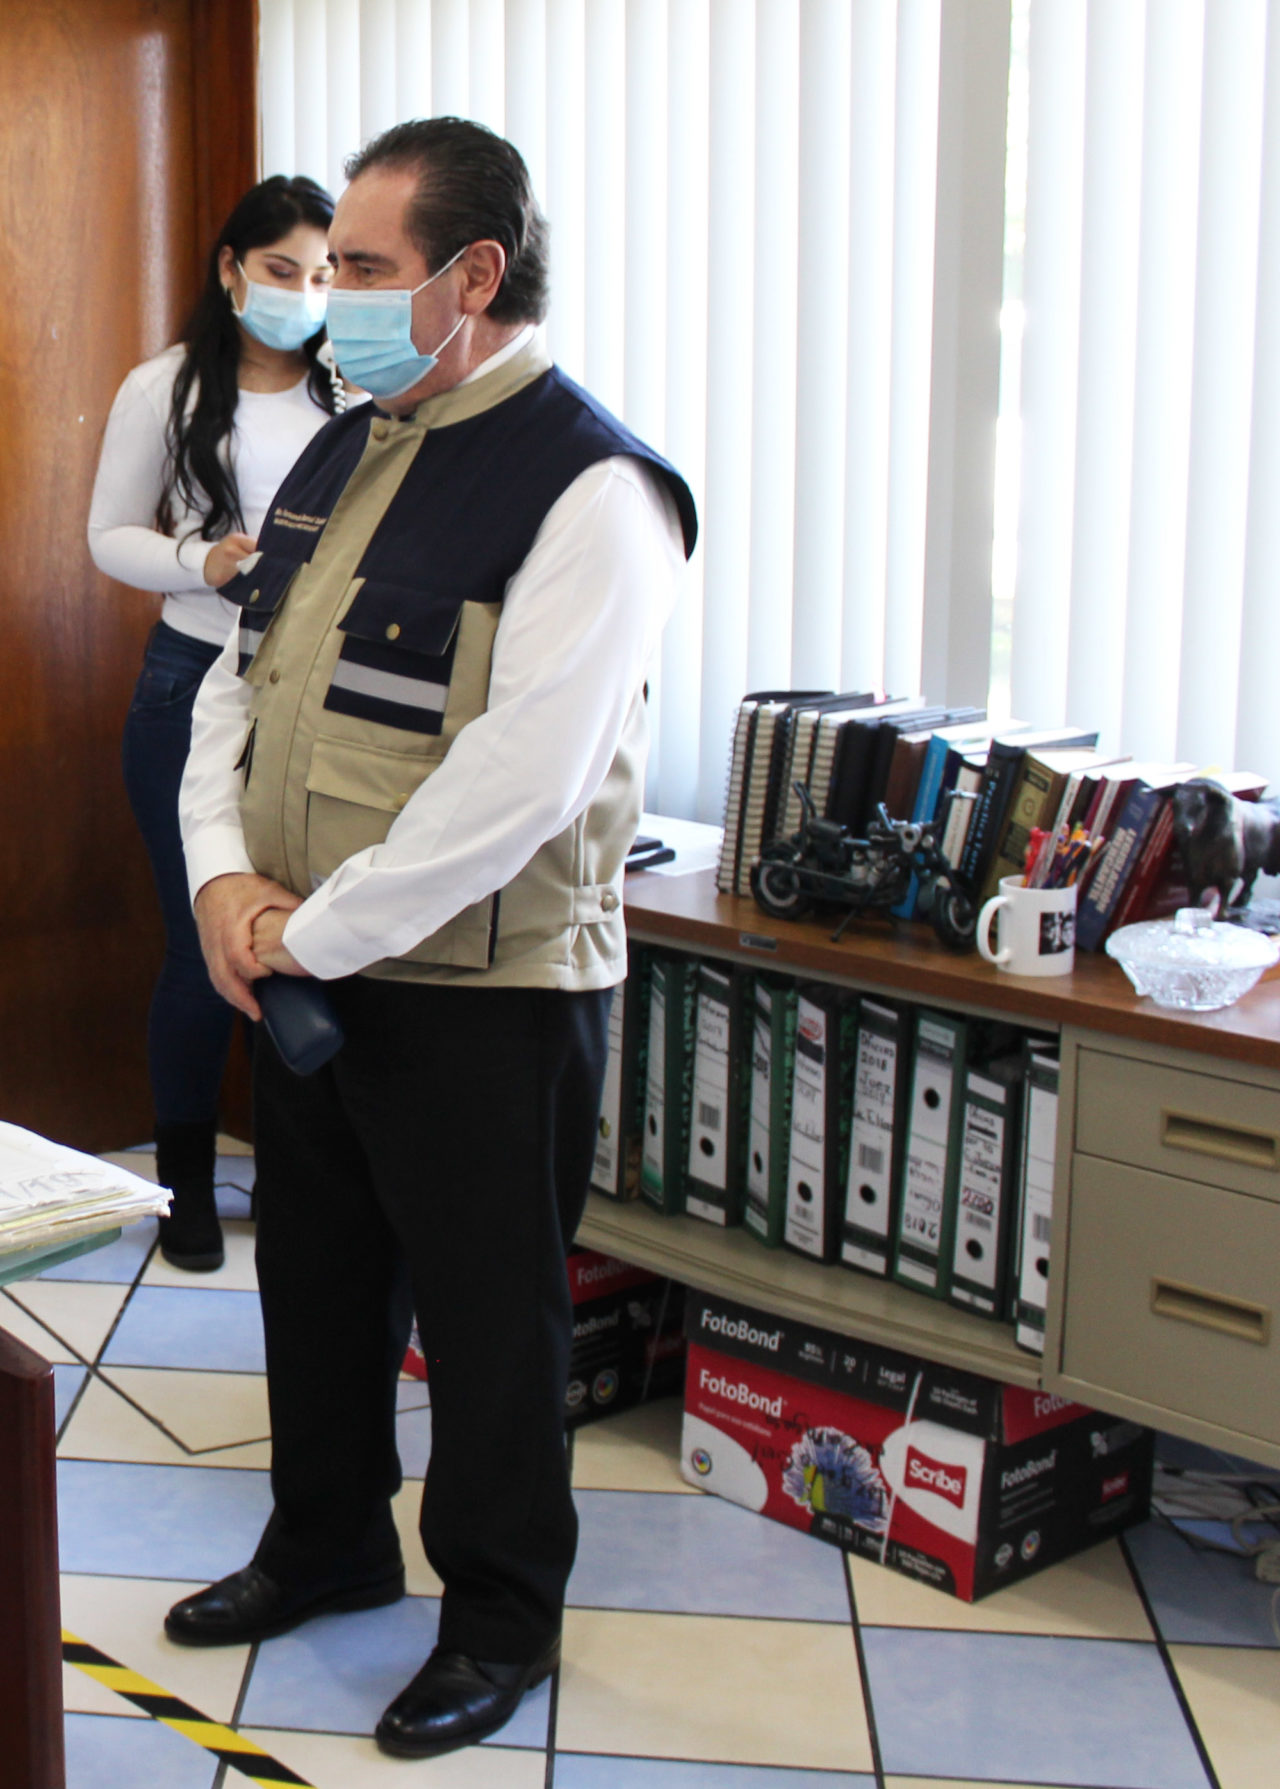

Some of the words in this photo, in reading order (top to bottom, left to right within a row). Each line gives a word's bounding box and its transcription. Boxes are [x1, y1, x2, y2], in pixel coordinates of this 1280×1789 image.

[700, 1308, 782, 1351] FotoBond
[699, 1368, 783, 1418] FotoBond
[909, 1458, 963, 1495] Scribe
[1000, 1449, 1058, 1490] FotoBond
